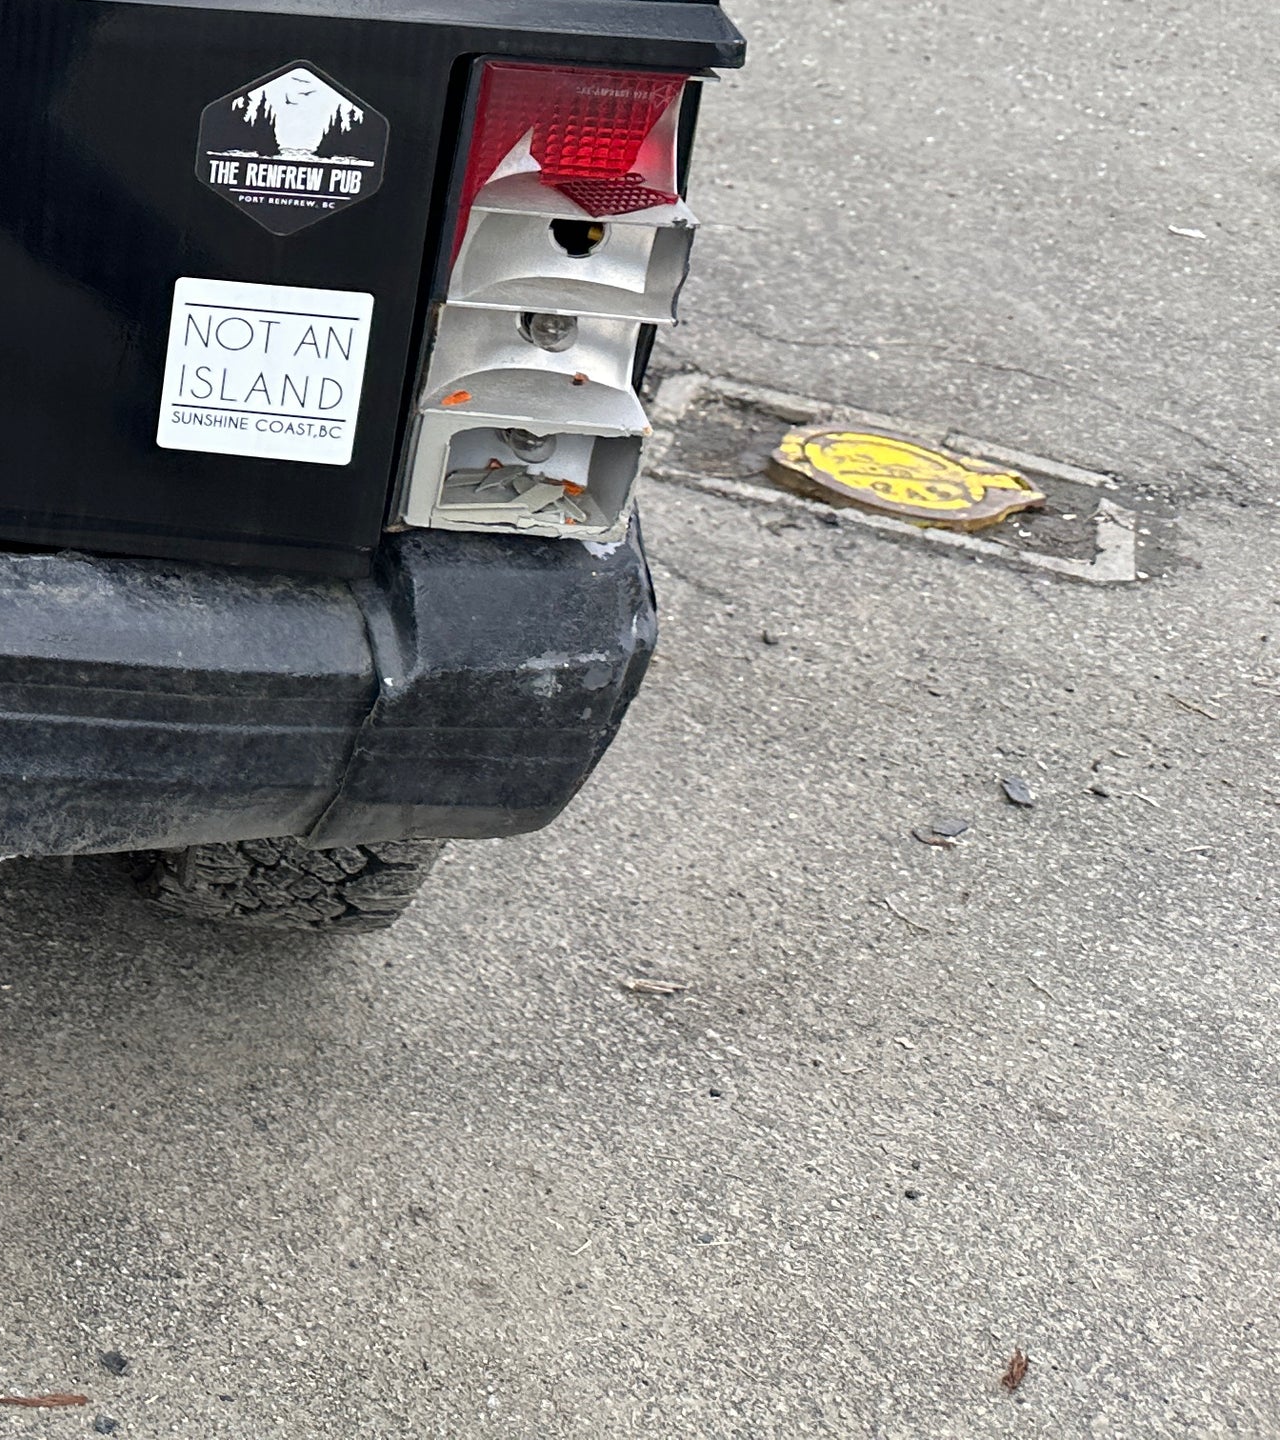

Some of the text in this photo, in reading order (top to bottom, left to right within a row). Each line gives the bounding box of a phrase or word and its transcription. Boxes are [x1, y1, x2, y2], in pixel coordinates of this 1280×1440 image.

[209, 159, 363, 195] THE RENFREW PUB
[238, 194, 265, 204] PORT
[322, 200, 336, 210] BC
[184, 312, 354, 361] NOT AN
[178, 363, 344, 411] ISLAND
[171, 410, 249, 431] SUNSHINE
